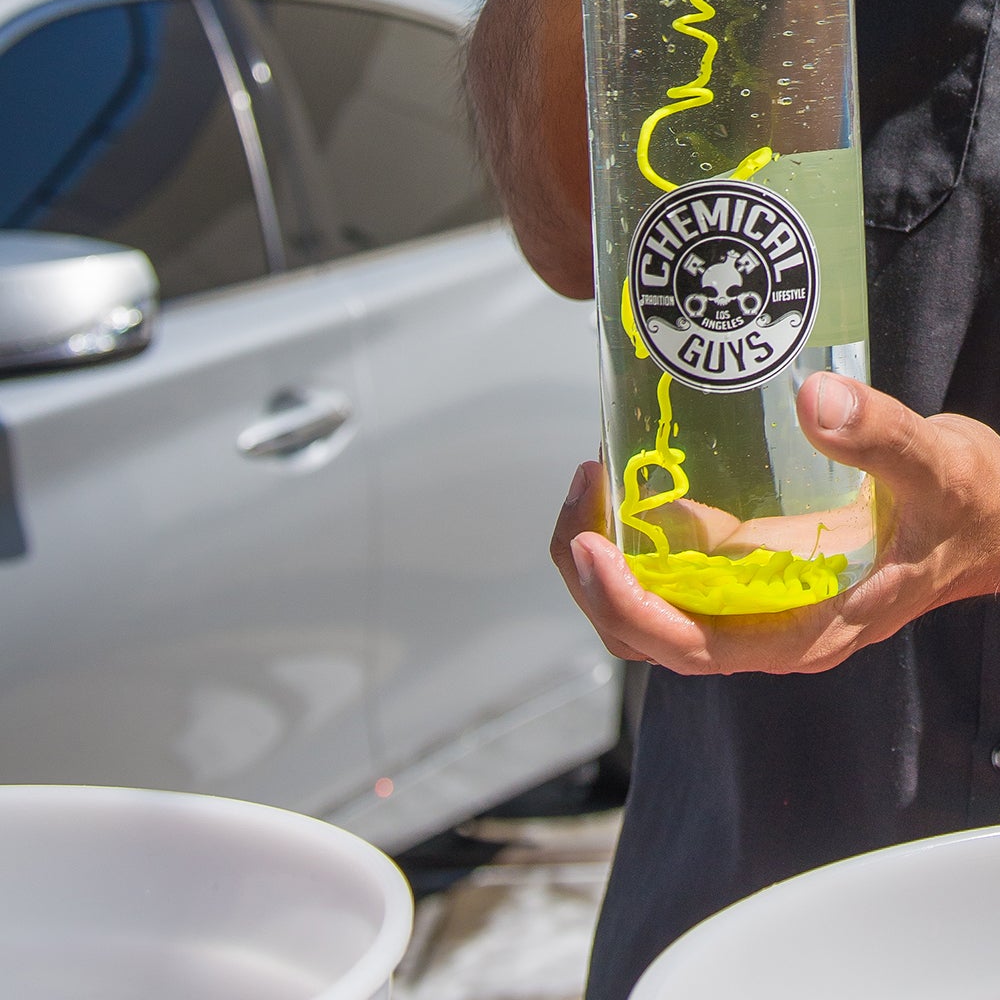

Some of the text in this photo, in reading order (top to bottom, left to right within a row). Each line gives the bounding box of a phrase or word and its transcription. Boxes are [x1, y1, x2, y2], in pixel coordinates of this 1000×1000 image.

[641, 197, 805, 287] CHEMICAL
[640, 288, 806, 307] TRADITION LIFESTYLE
[702, 316, 745, 330] ANGELES
[715, 310, 730, 319] LOS
[677, 331, 774, 373] GUYS
